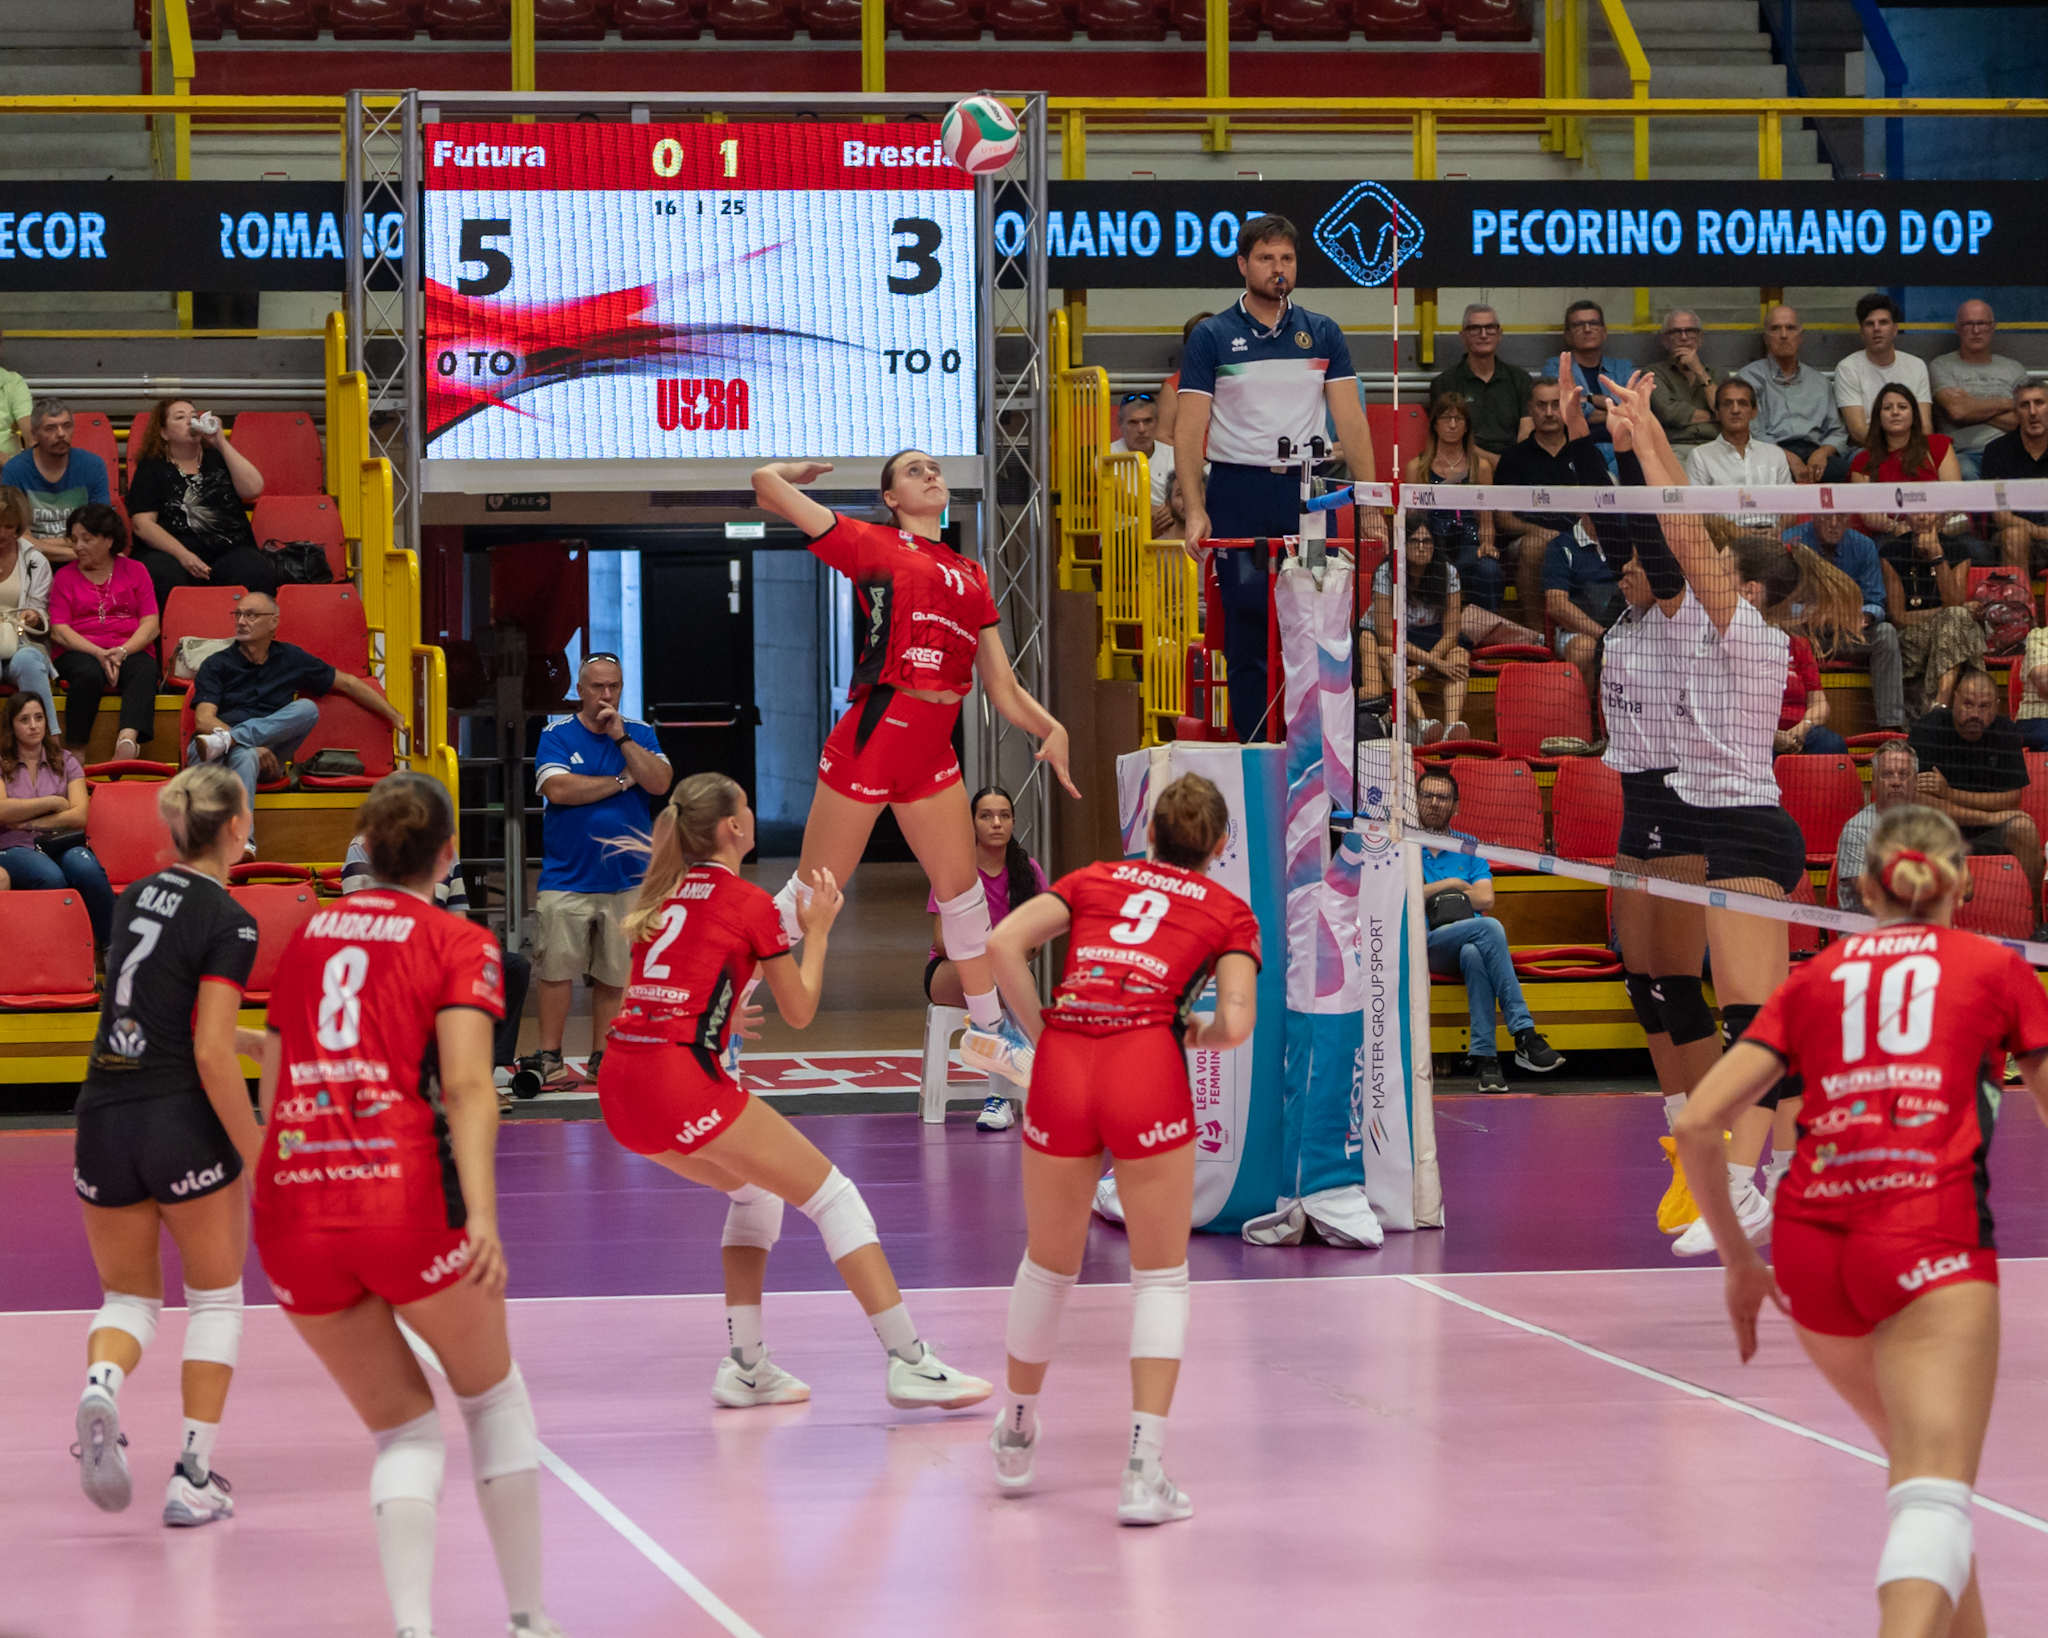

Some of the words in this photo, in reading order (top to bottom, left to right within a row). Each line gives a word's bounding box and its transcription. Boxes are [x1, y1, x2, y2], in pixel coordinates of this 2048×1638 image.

[433, 140, 546, 167] Futura
[652, 138, 684, 177] 0
[719, 139, 739, 178] 1
[655, 200, 677, 215] 16
[720, 200, 744, 215] 25
[1175, 210, 1266, 258] DO
[1472, 209, 1683, 255] PECORINO
[1698, 209, 1887, 255] ROMANO
[1900, 210, 1993, 255] DOP
[457, 218, 512, 296] 5
[887, 216, 943, 296] 3
[437, 352, 457, 376] 0
[467, 351, 516, 376] TO
[883, 350, 932, 375] TO
[941, 349, 961, 373] 0
[656, 378, 749, 431] UYBA
[936, 562, 965, 596] 11
[136, 885, 183, 918] BLASI
[1112, 865, 1208, 901] SASSOLINI
[304, 911, 416, 943] MAIORANO
[1109, 889, 1171, 945] 9
[643, 904, 688, 980] 2
[1843, 932, 1938, 958] FARINA
[114, 917, 163, 1007] 7
[317, 945, 370, 1052] 8
[1830, 954, 1942, 1064] 10
[1196, 1077, 1207, 1110] LEGA
[1372, 1041, 1385, 1109] MASTER
[675, 1108, 722, 1145] viar
[1138, 1118, 1188, 1148] viar
[170, 1161, 225, 1196] viar
